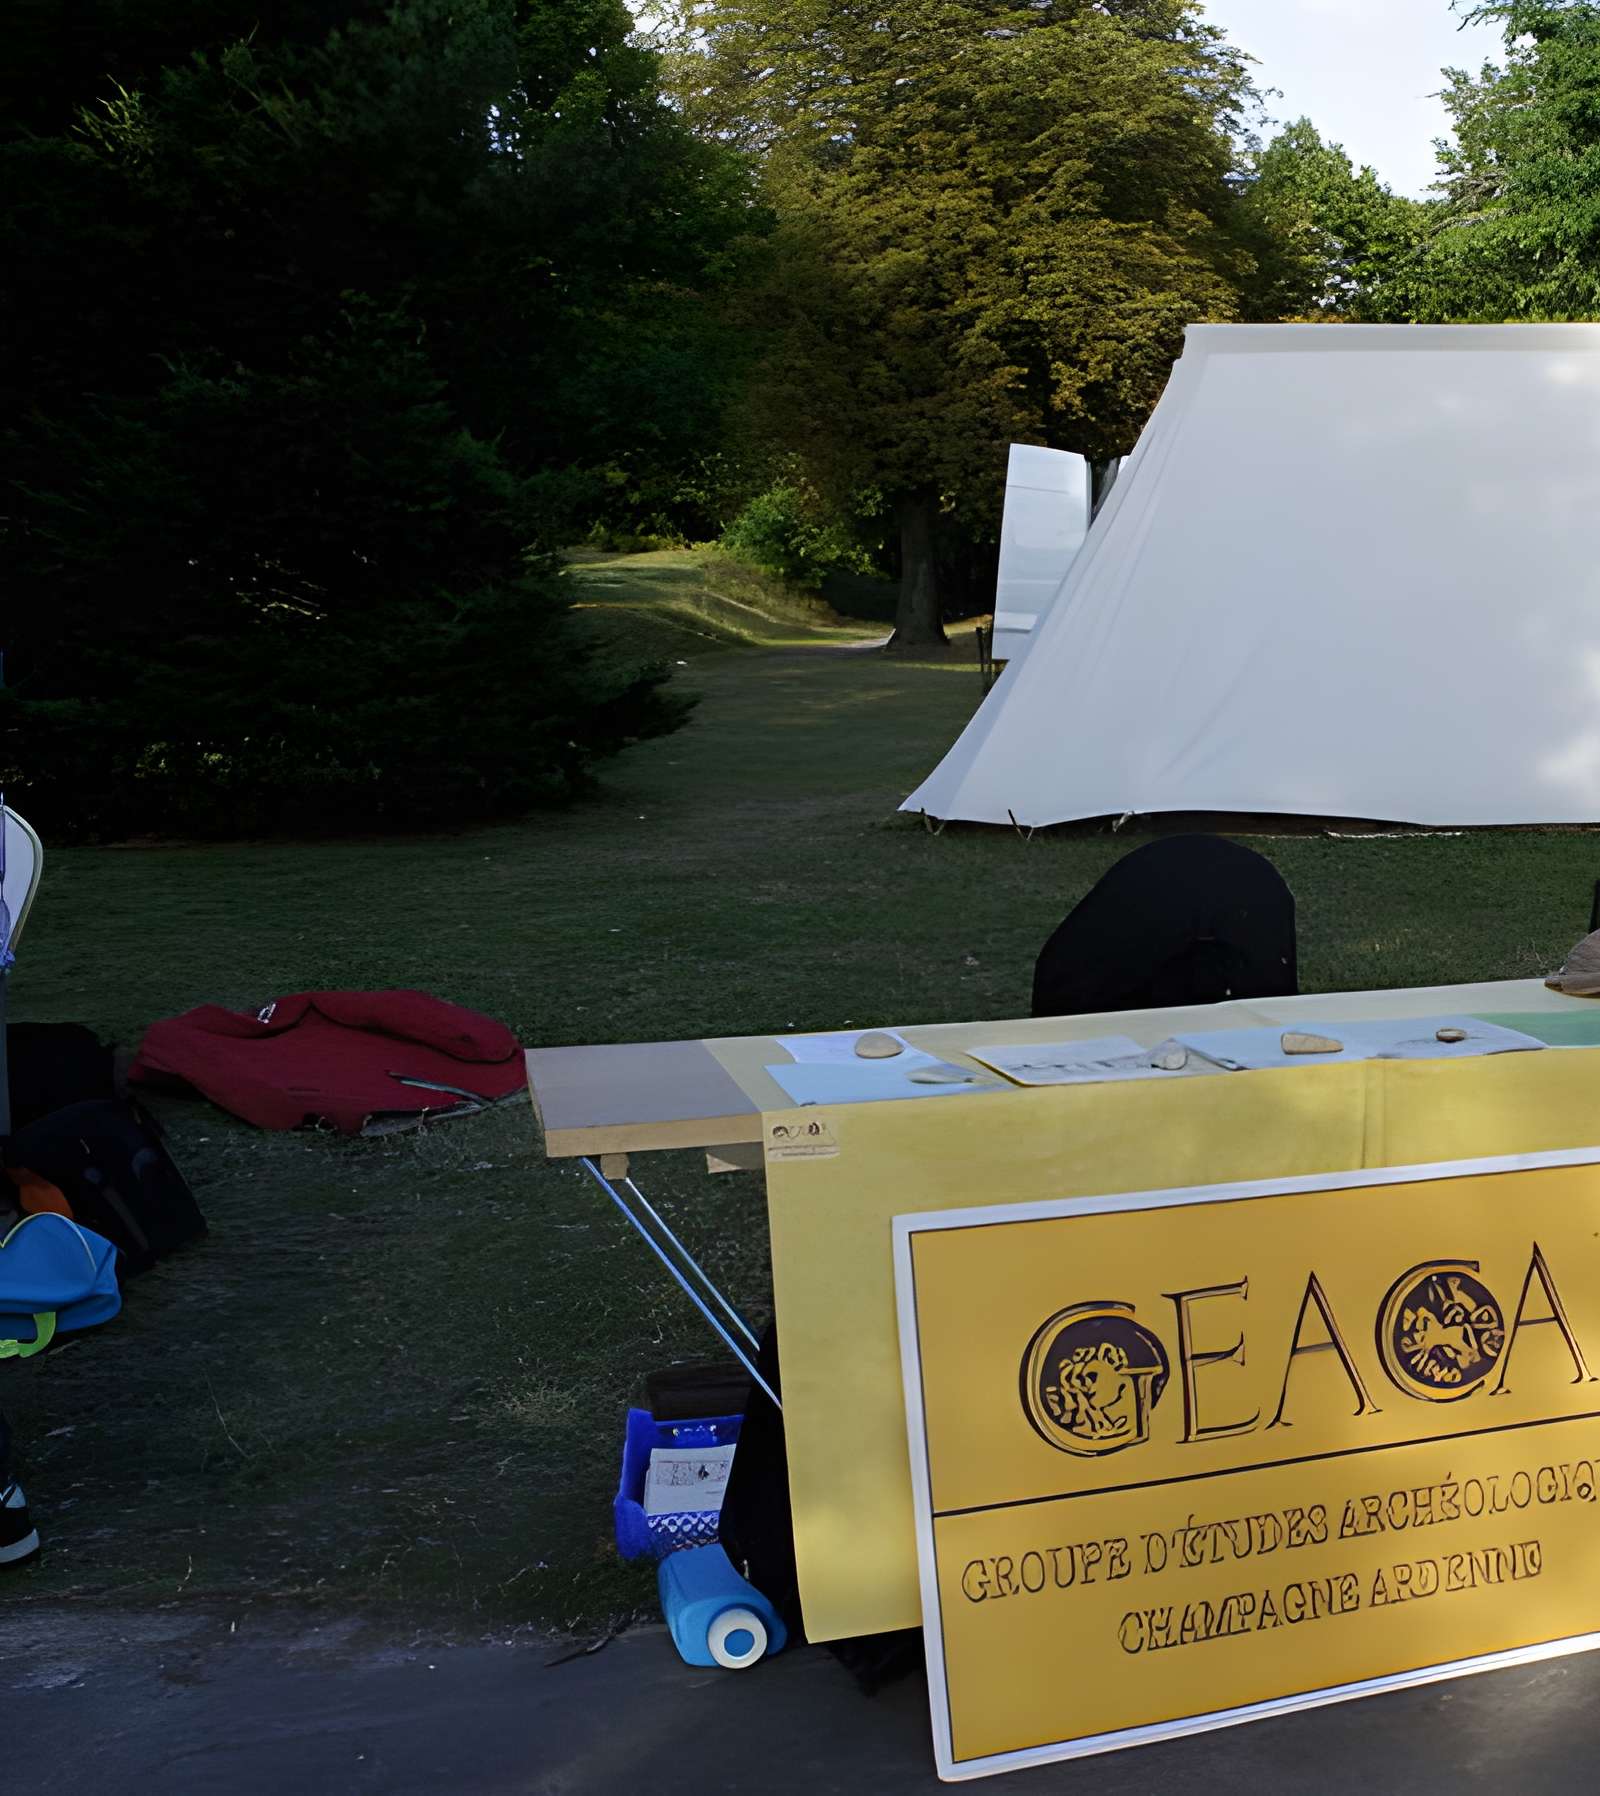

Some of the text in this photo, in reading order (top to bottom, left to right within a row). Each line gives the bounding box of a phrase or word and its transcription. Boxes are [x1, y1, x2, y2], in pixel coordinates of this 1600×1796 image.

[961, 1537, 1132, 1603] GROUPE
[1139, 1504, 1328, 1574] D'ÉTUDES
[1118, 1540, 1543, 1654] CHAMPAGNE ARDENNE
